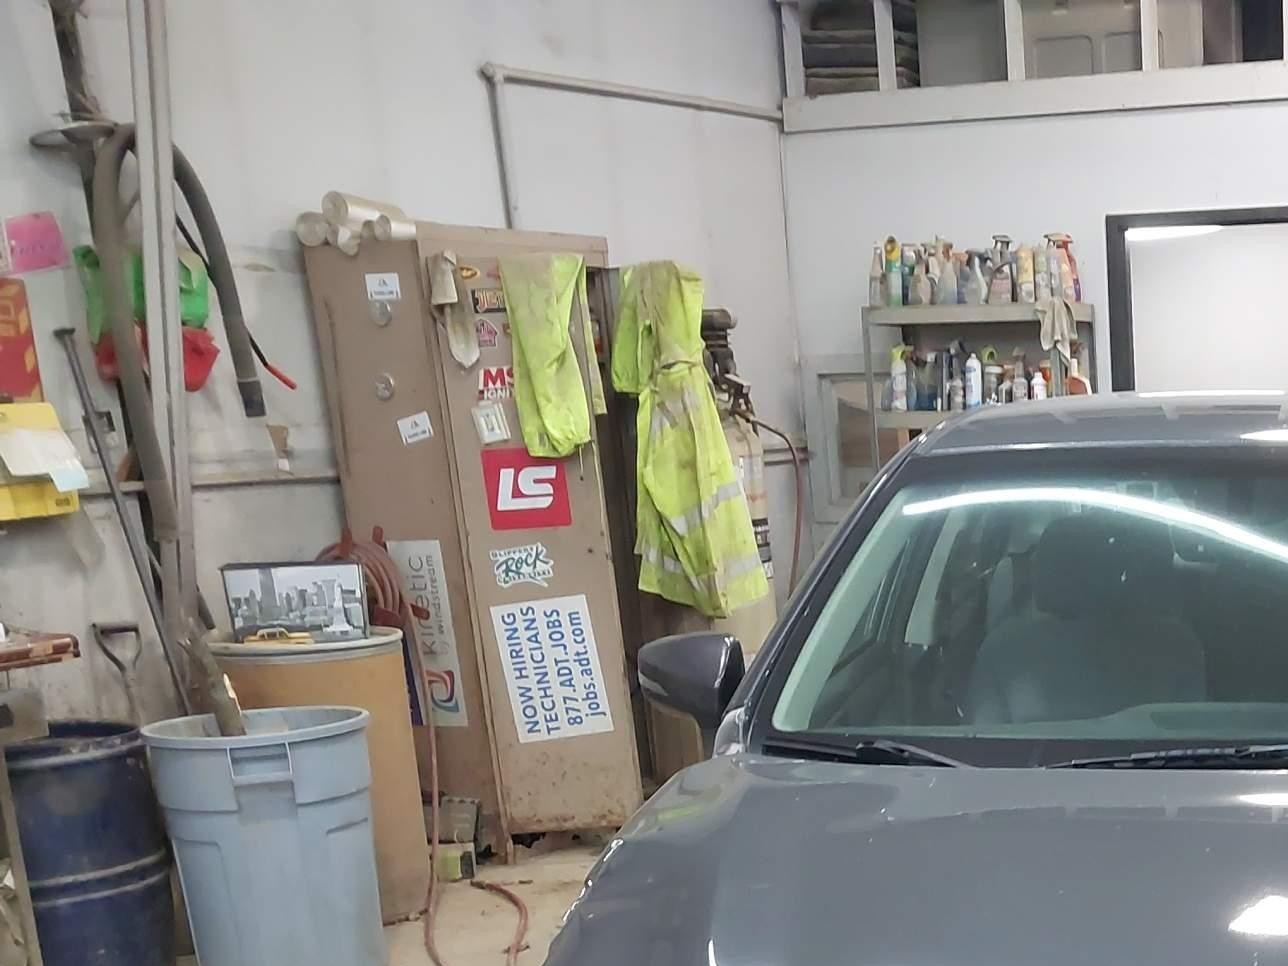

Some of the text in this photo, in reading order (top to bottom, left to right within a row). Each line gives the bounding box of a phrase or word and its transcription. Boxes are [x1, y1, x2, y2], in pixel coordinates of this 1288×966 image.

[484, 388, 514, 400] IGNI
[497, 465, 557, 511] LS
[502, 612, 529, 679] HIRING
[520, 606, 560, 735] TECHNICIANS
[568, 611, 607, 717] jobs.adt.com
[518, 686, 541, 733] NOW
